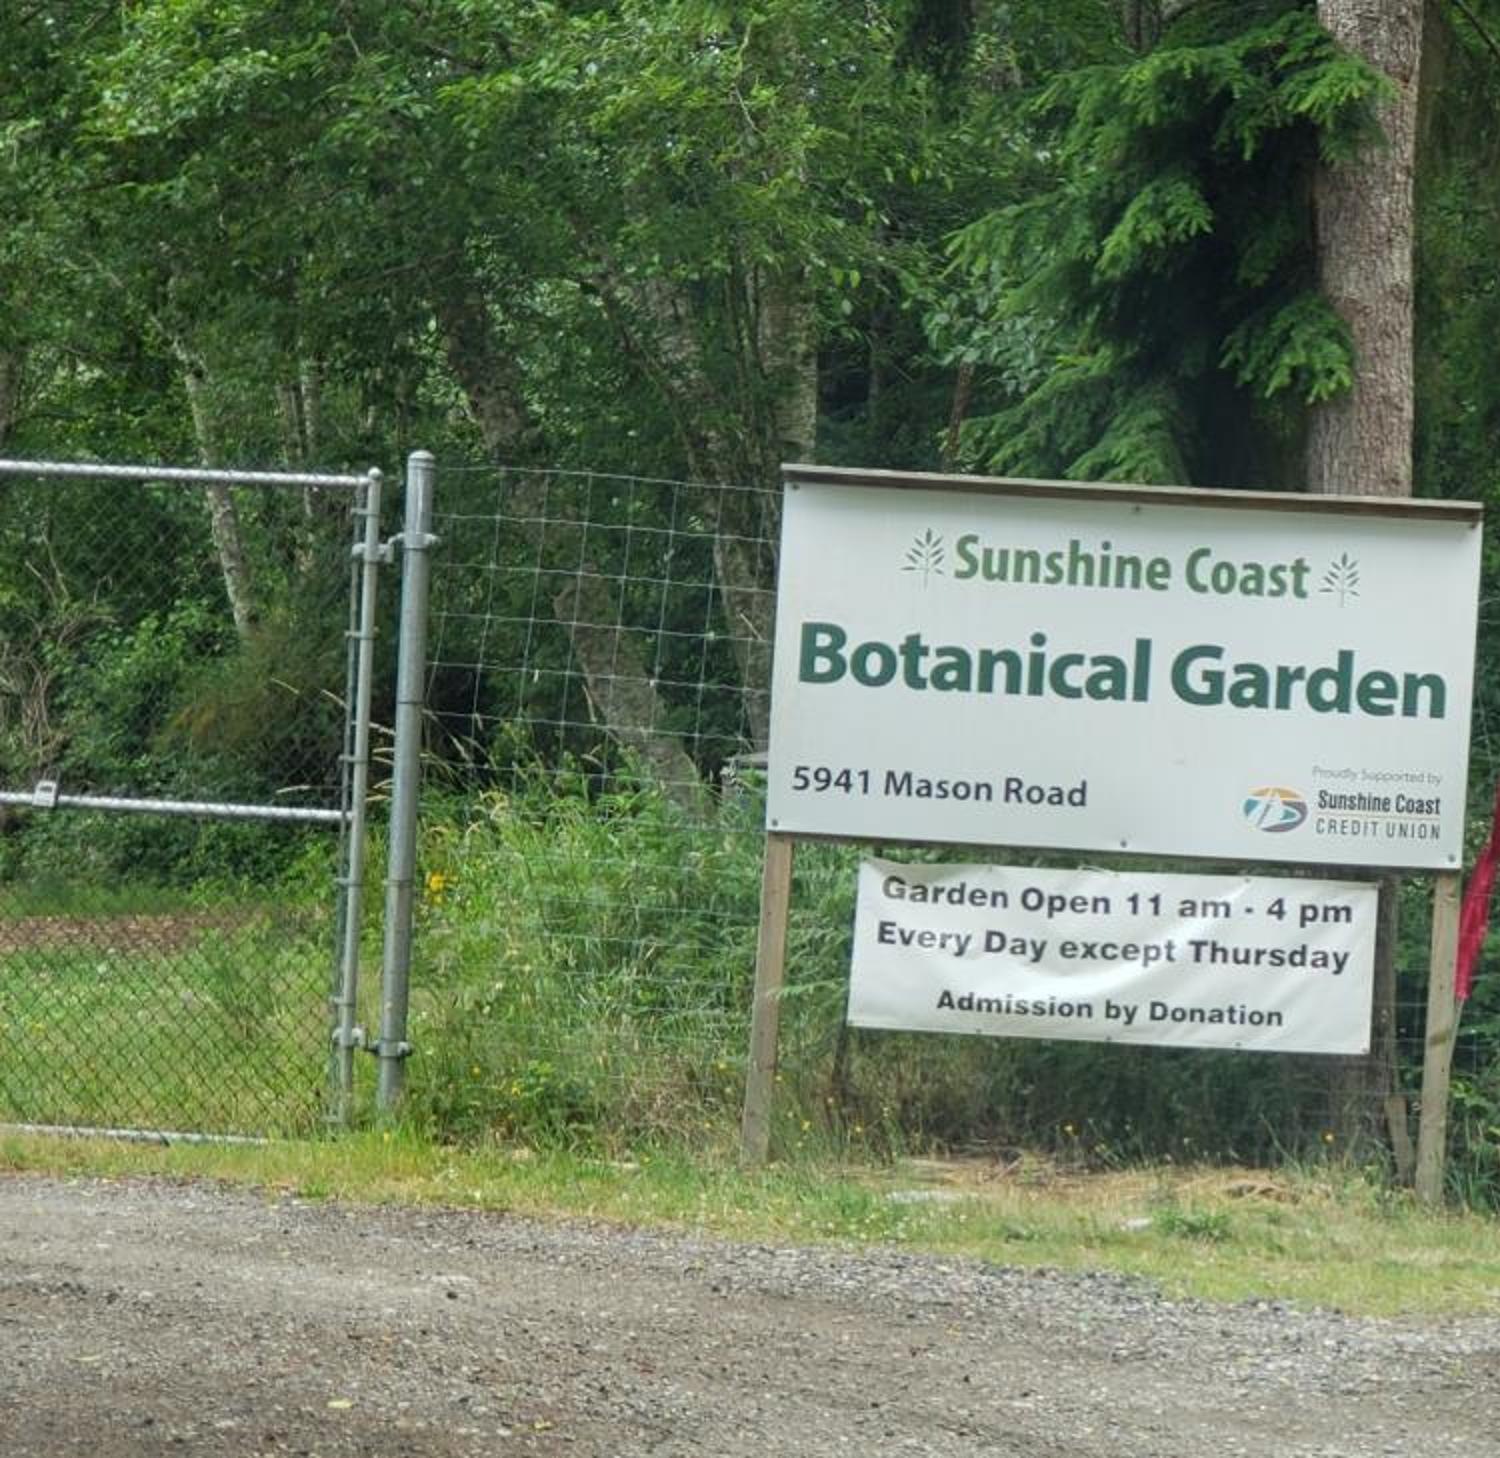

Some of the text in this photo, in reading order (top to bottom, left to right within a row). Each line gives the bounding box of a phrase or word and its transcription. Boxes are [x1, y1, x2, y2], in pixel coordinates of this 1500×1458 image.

[954, 534, 1311, 599] Sunshine Coast
[799, 621, 1447, 719] Botanical Garden
[792, 766, 1087, 807] 5941 Mason Road
[1312, 766, 1442, 786] Proudly Supported by
[1317, 789, 1441, 815] Sunshine Coast
[1315, 818, 1441, 840] CREDIT UNION
[882, 876, 1009, 909] Garden
[1021, 887, 1111, 918] Open
[1127, 893, 1162, 917] 11
[1178, 898, 1232, 920] am
[1266, 898, 1286, 921] 4
[1300, 902, 1353, 928] pm
[877, 921, 1351, 975] Every Day except Thursday
[936, 989, 1284, 1027] Admission by Donation
